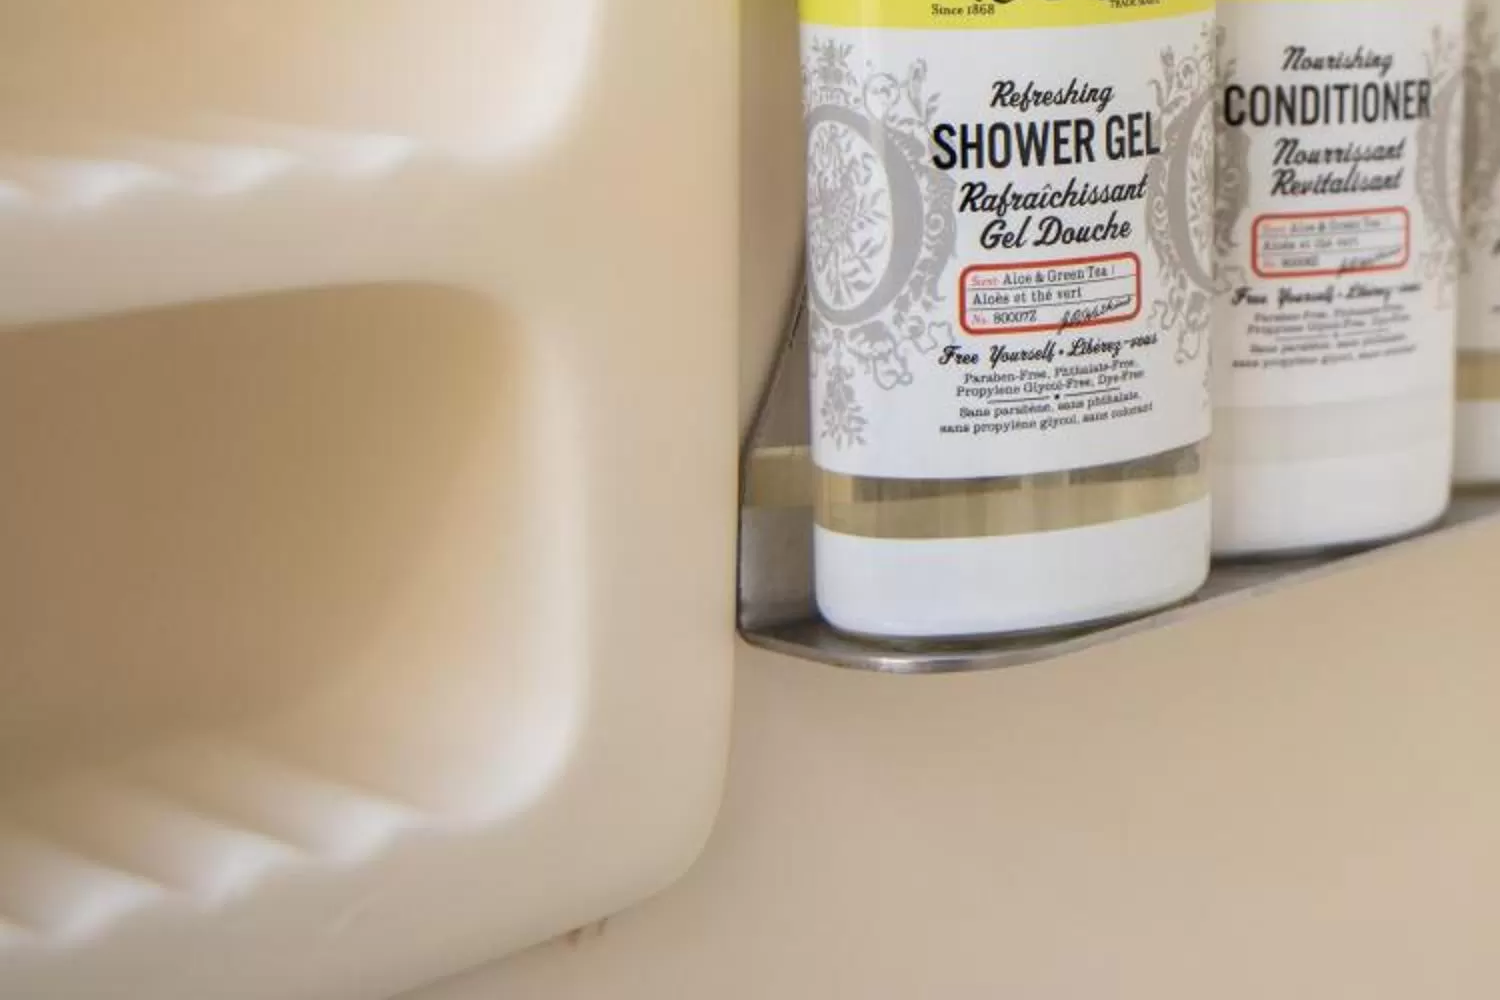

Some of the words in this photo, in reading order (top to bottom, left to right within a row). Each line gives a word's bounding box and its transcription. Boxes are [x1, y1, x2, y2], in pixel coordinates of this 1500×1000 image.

[931, 3, 964, 15] Since
[966, 3, 995, 15] 1868
[1281, 45, 1394, 78] Nourishing
[990, 77, 1114, 112] Refreshing
[1223, 79, 1432, 127] CONDITIONER
[932, 118, 1095, 170] SHOWER
[1106, 112, 1161, 161] GEL
[1272, 136, 1407, 167] Nourrissant
[959, 174, 1148, 216] Rafraîchissant
[1270, 164, 1405, 197] Revitalisant
[980, 216, 1031, 250] Gel
[1034, 210, 1132, 247] Douche
[1003, 273, 1032, 286] Aloe
[1035, 271, 1044, 283] &
[1048, 268, 1085, 283] Green
[1088, 265, 1107, 279] Tea
[1014, 291, 1025, 303] et
[1057, 286, 1082, 299] vert
[938, 345, 979, 366] Free
[989, 340, 1056, 369] Yourself
[956, 383, 1020, 398] Propylene
[959, 406, 990, 418] Sans
[939, 424, 970, 435] sans
